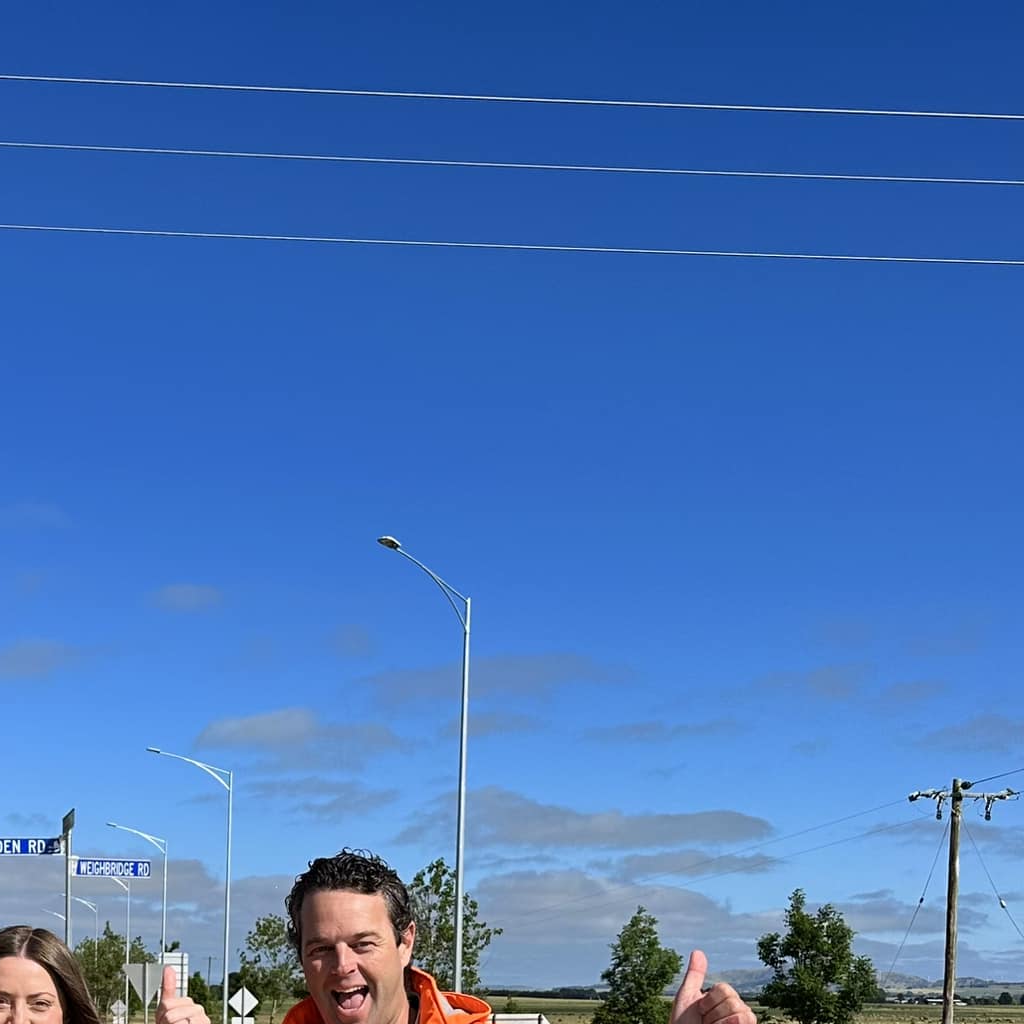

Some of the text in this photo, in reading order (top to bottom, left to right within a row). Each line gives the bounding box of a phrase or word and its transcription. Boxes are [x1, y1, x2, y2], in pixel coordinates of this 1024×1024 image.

[28, 839, 46, 854] RD
[80, 860, 150, 876] WEIGHBRIDGE RD
